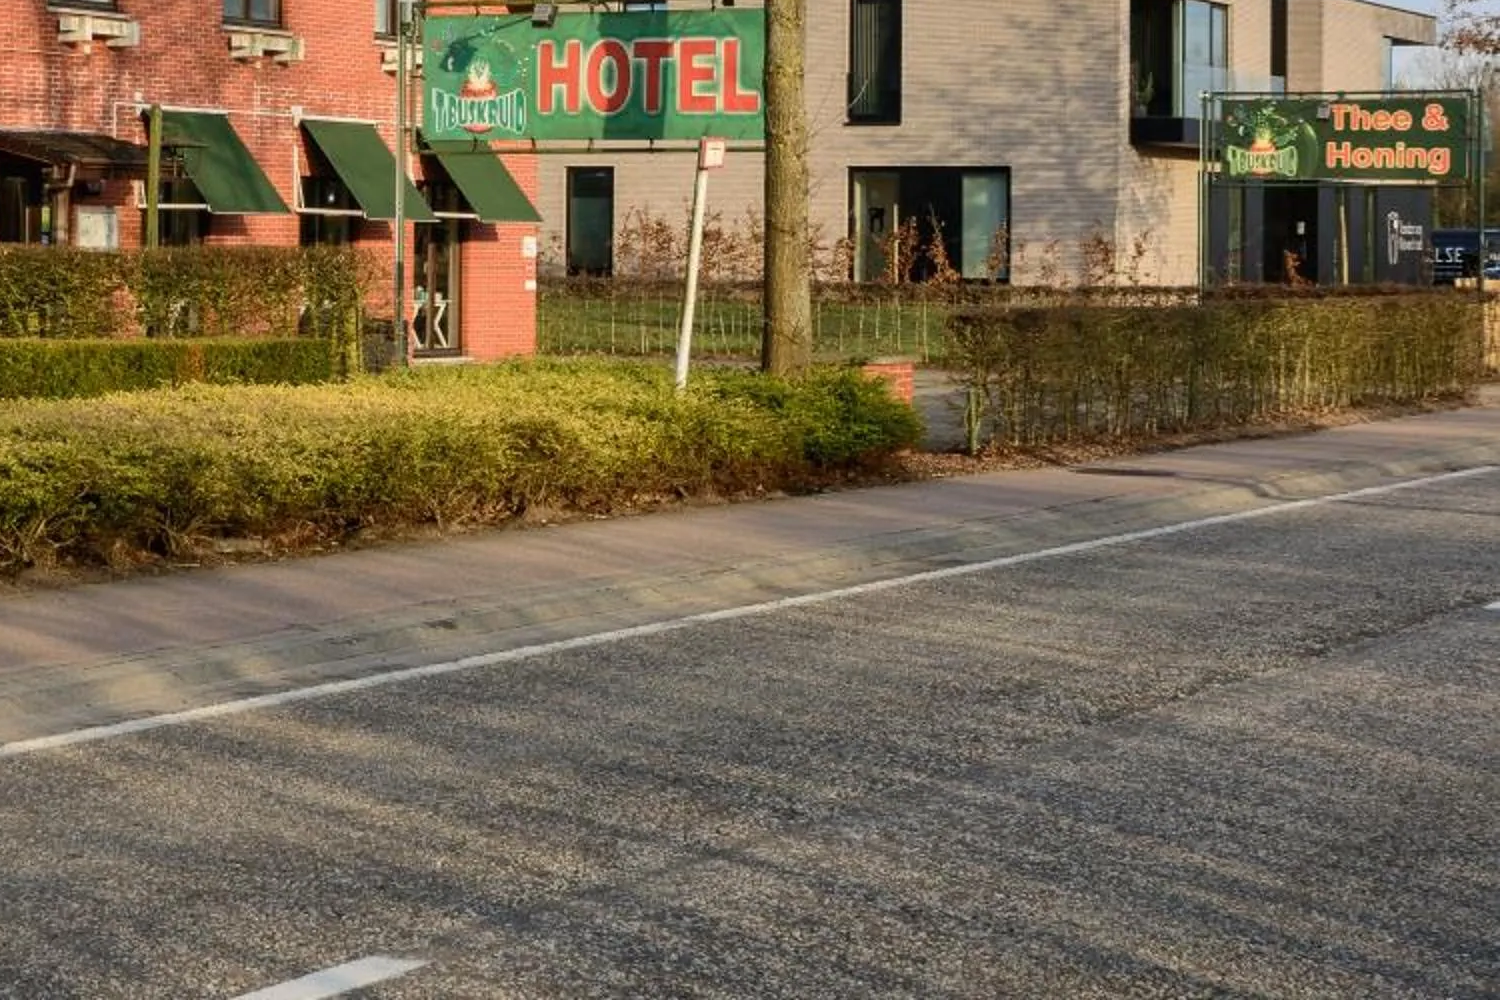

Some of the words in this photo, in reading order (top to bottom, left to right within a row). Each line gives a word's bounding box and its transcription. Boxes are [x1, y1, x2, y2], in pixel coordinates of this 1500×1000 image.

[536, 38, 761, 114] HOTEL
[1331, 103, 1413, 132] Thee
[1422, 103, 1449, 132] &
[1325, 141, 1451, 175] Honing
